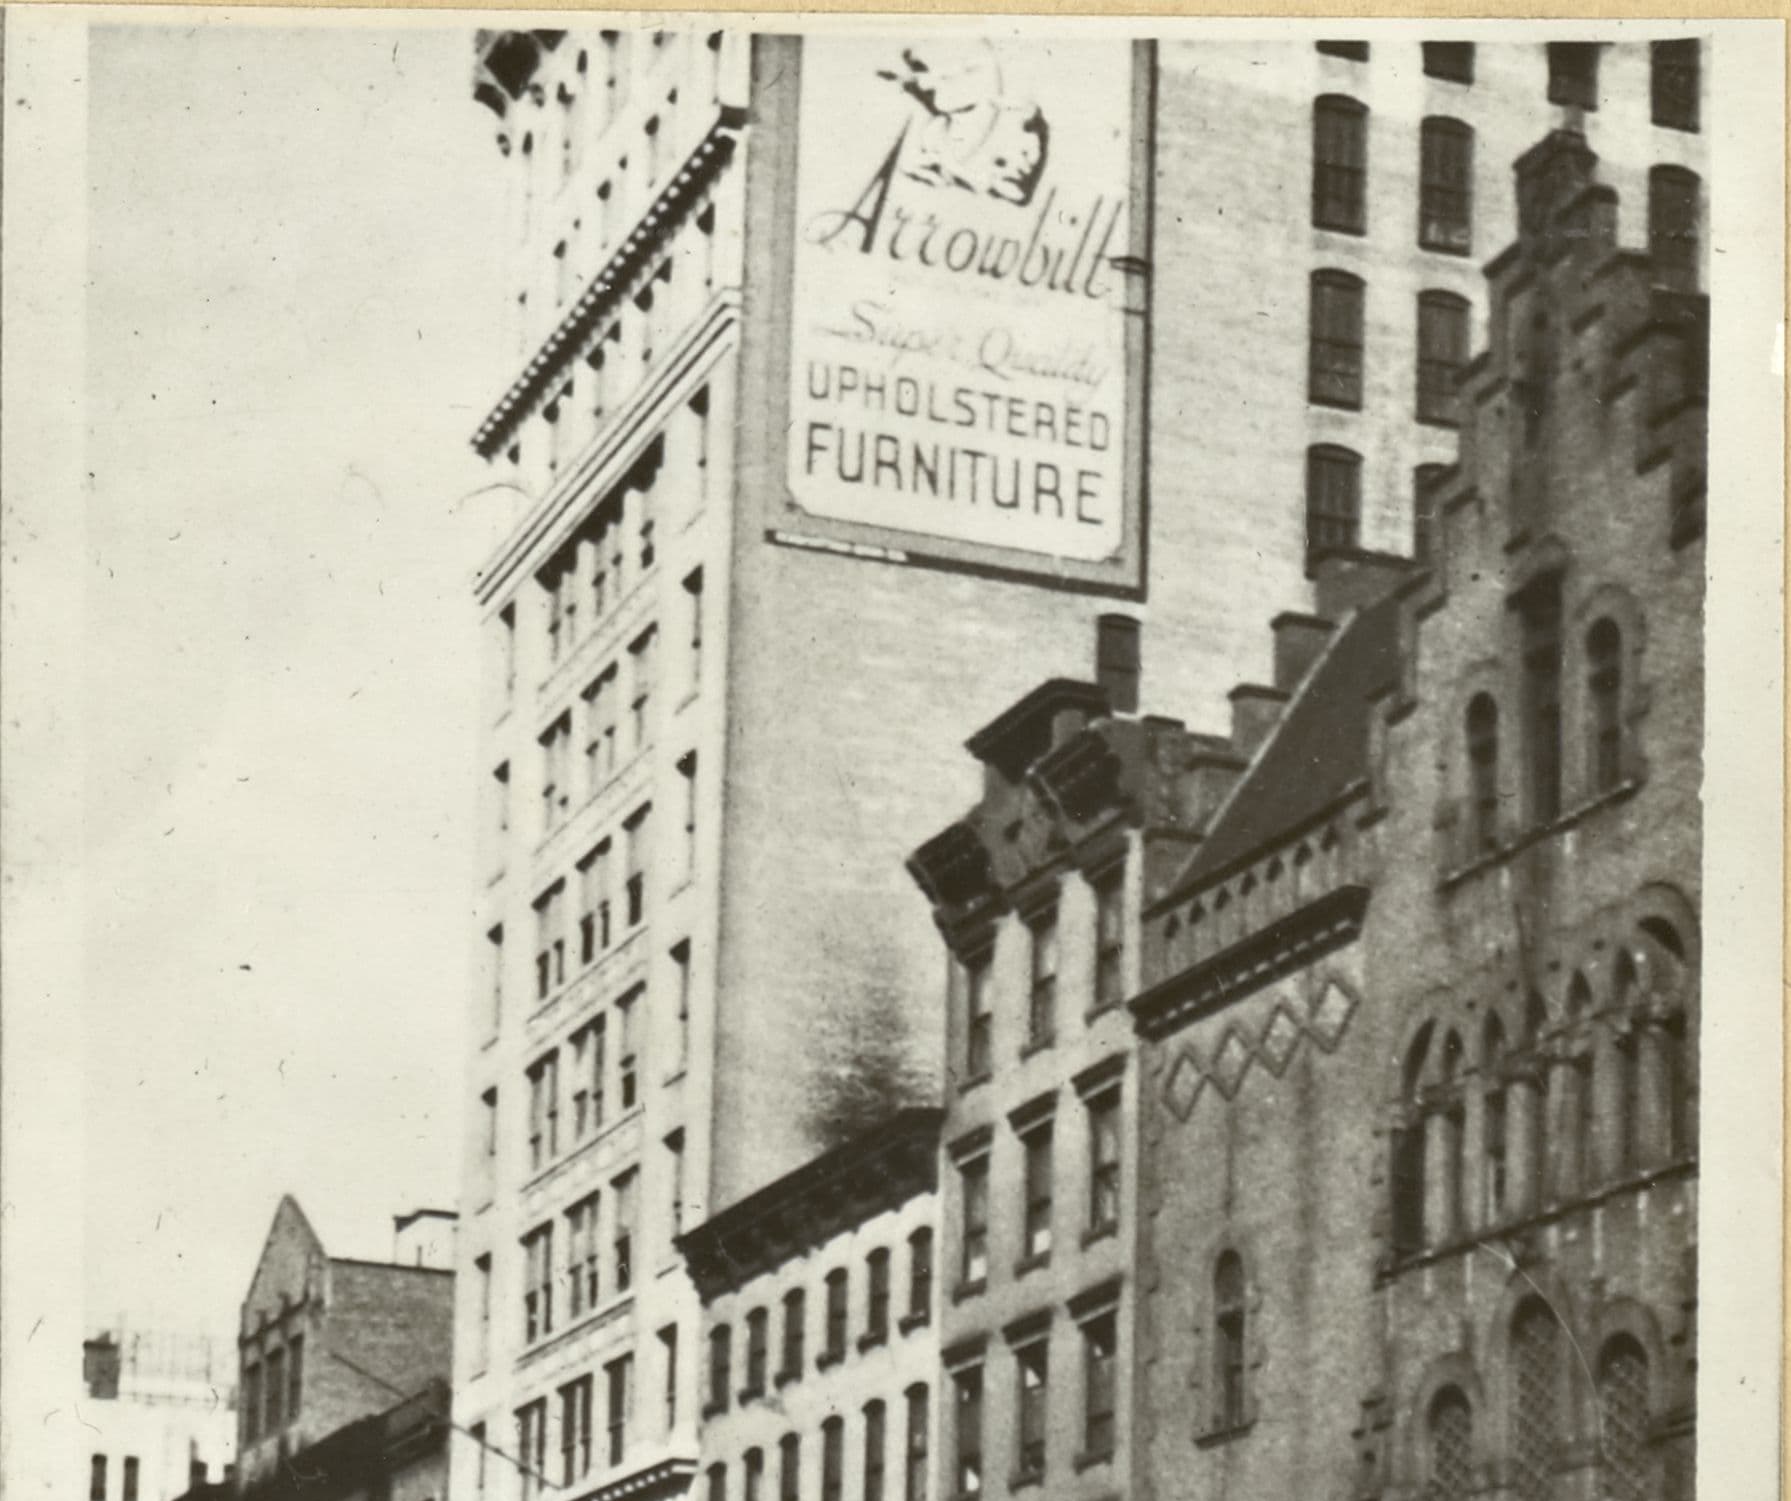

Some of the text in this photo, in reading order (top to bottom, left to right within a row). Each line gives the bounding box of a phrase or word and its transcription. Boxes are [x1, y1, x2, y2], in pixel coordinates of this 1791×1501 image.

[803, 113, 1122, 298] Arrowbilt
[806, 360, 1110, 452] UPHOLSTERED
[805, 422, 1105, 526] FURNITURE
